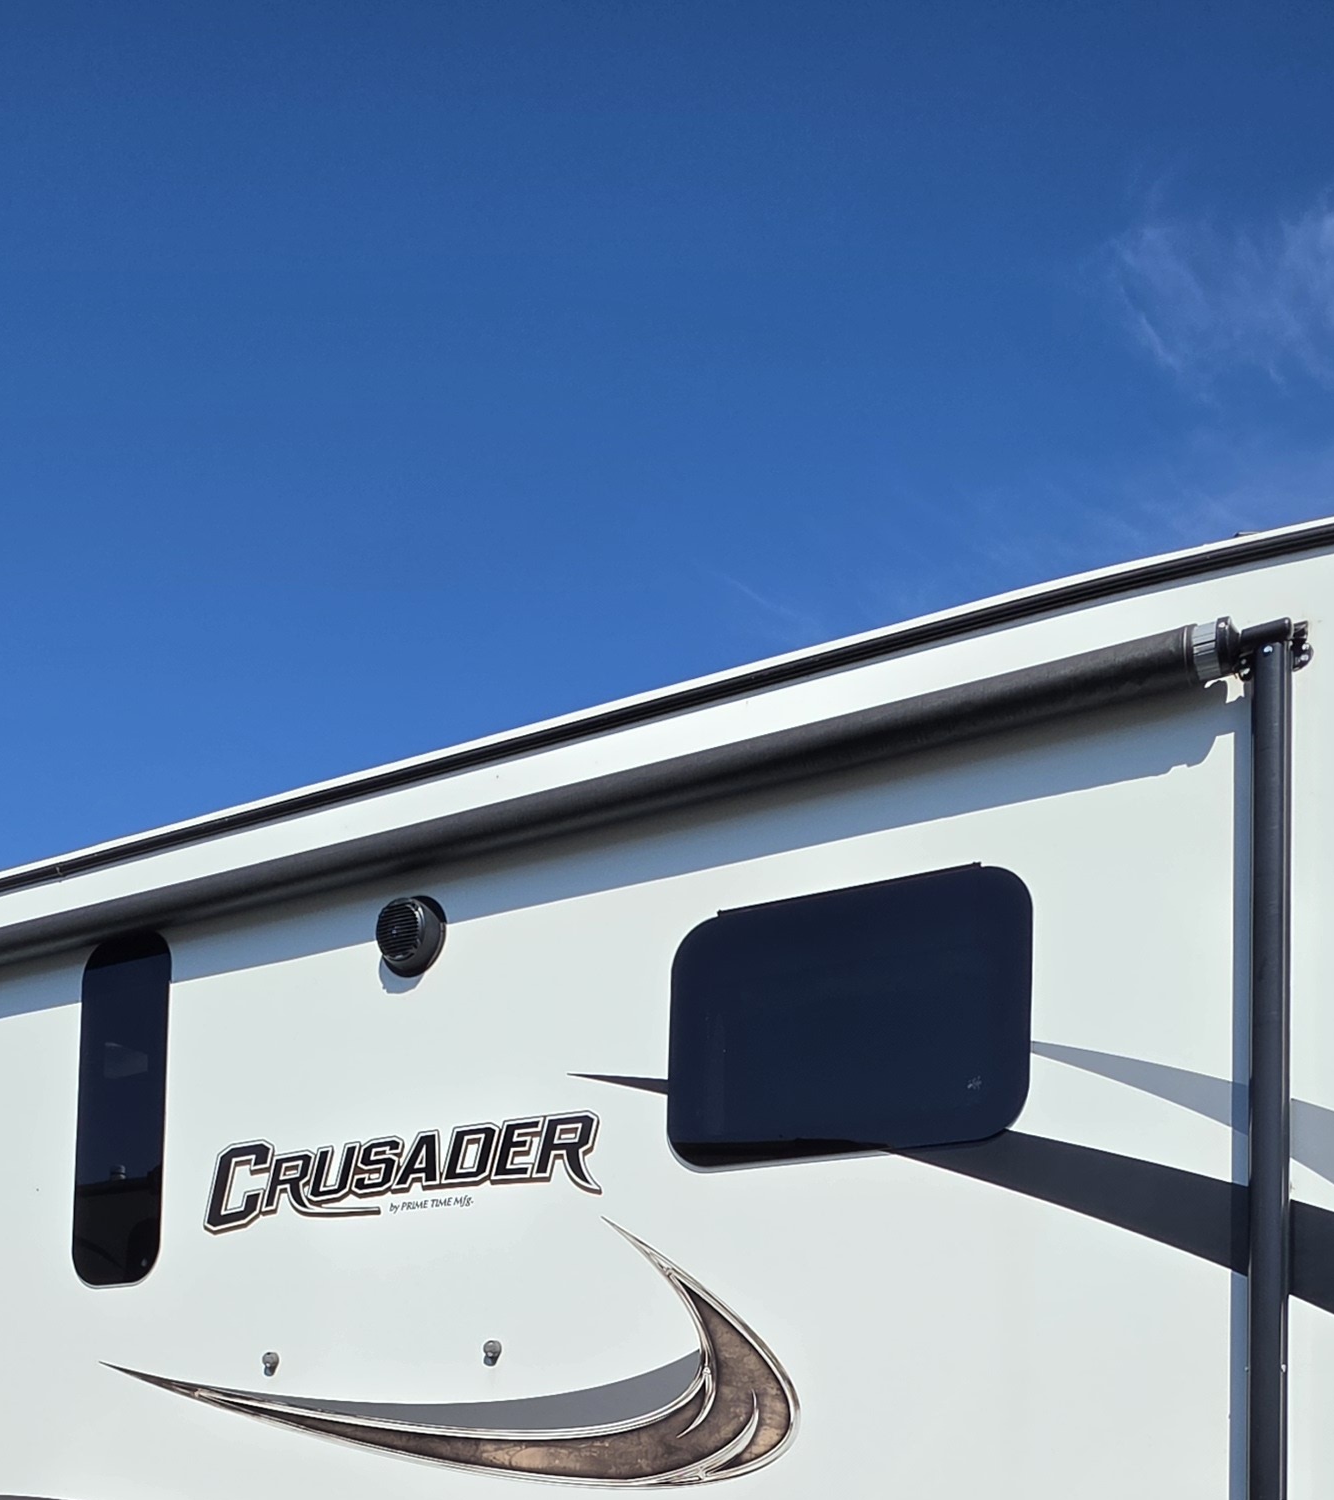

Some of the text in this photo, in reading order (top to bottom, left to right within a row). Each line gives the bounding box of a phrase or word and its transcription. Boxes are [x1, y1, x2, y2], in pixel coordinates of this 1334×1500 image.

[203, 1110, 602, 1235] CRUSADER
[389, 1203, 400, 1214] by
[400, 1200, 429, 1211] PRIME
[430, 1197, 453, 1208] TIME
